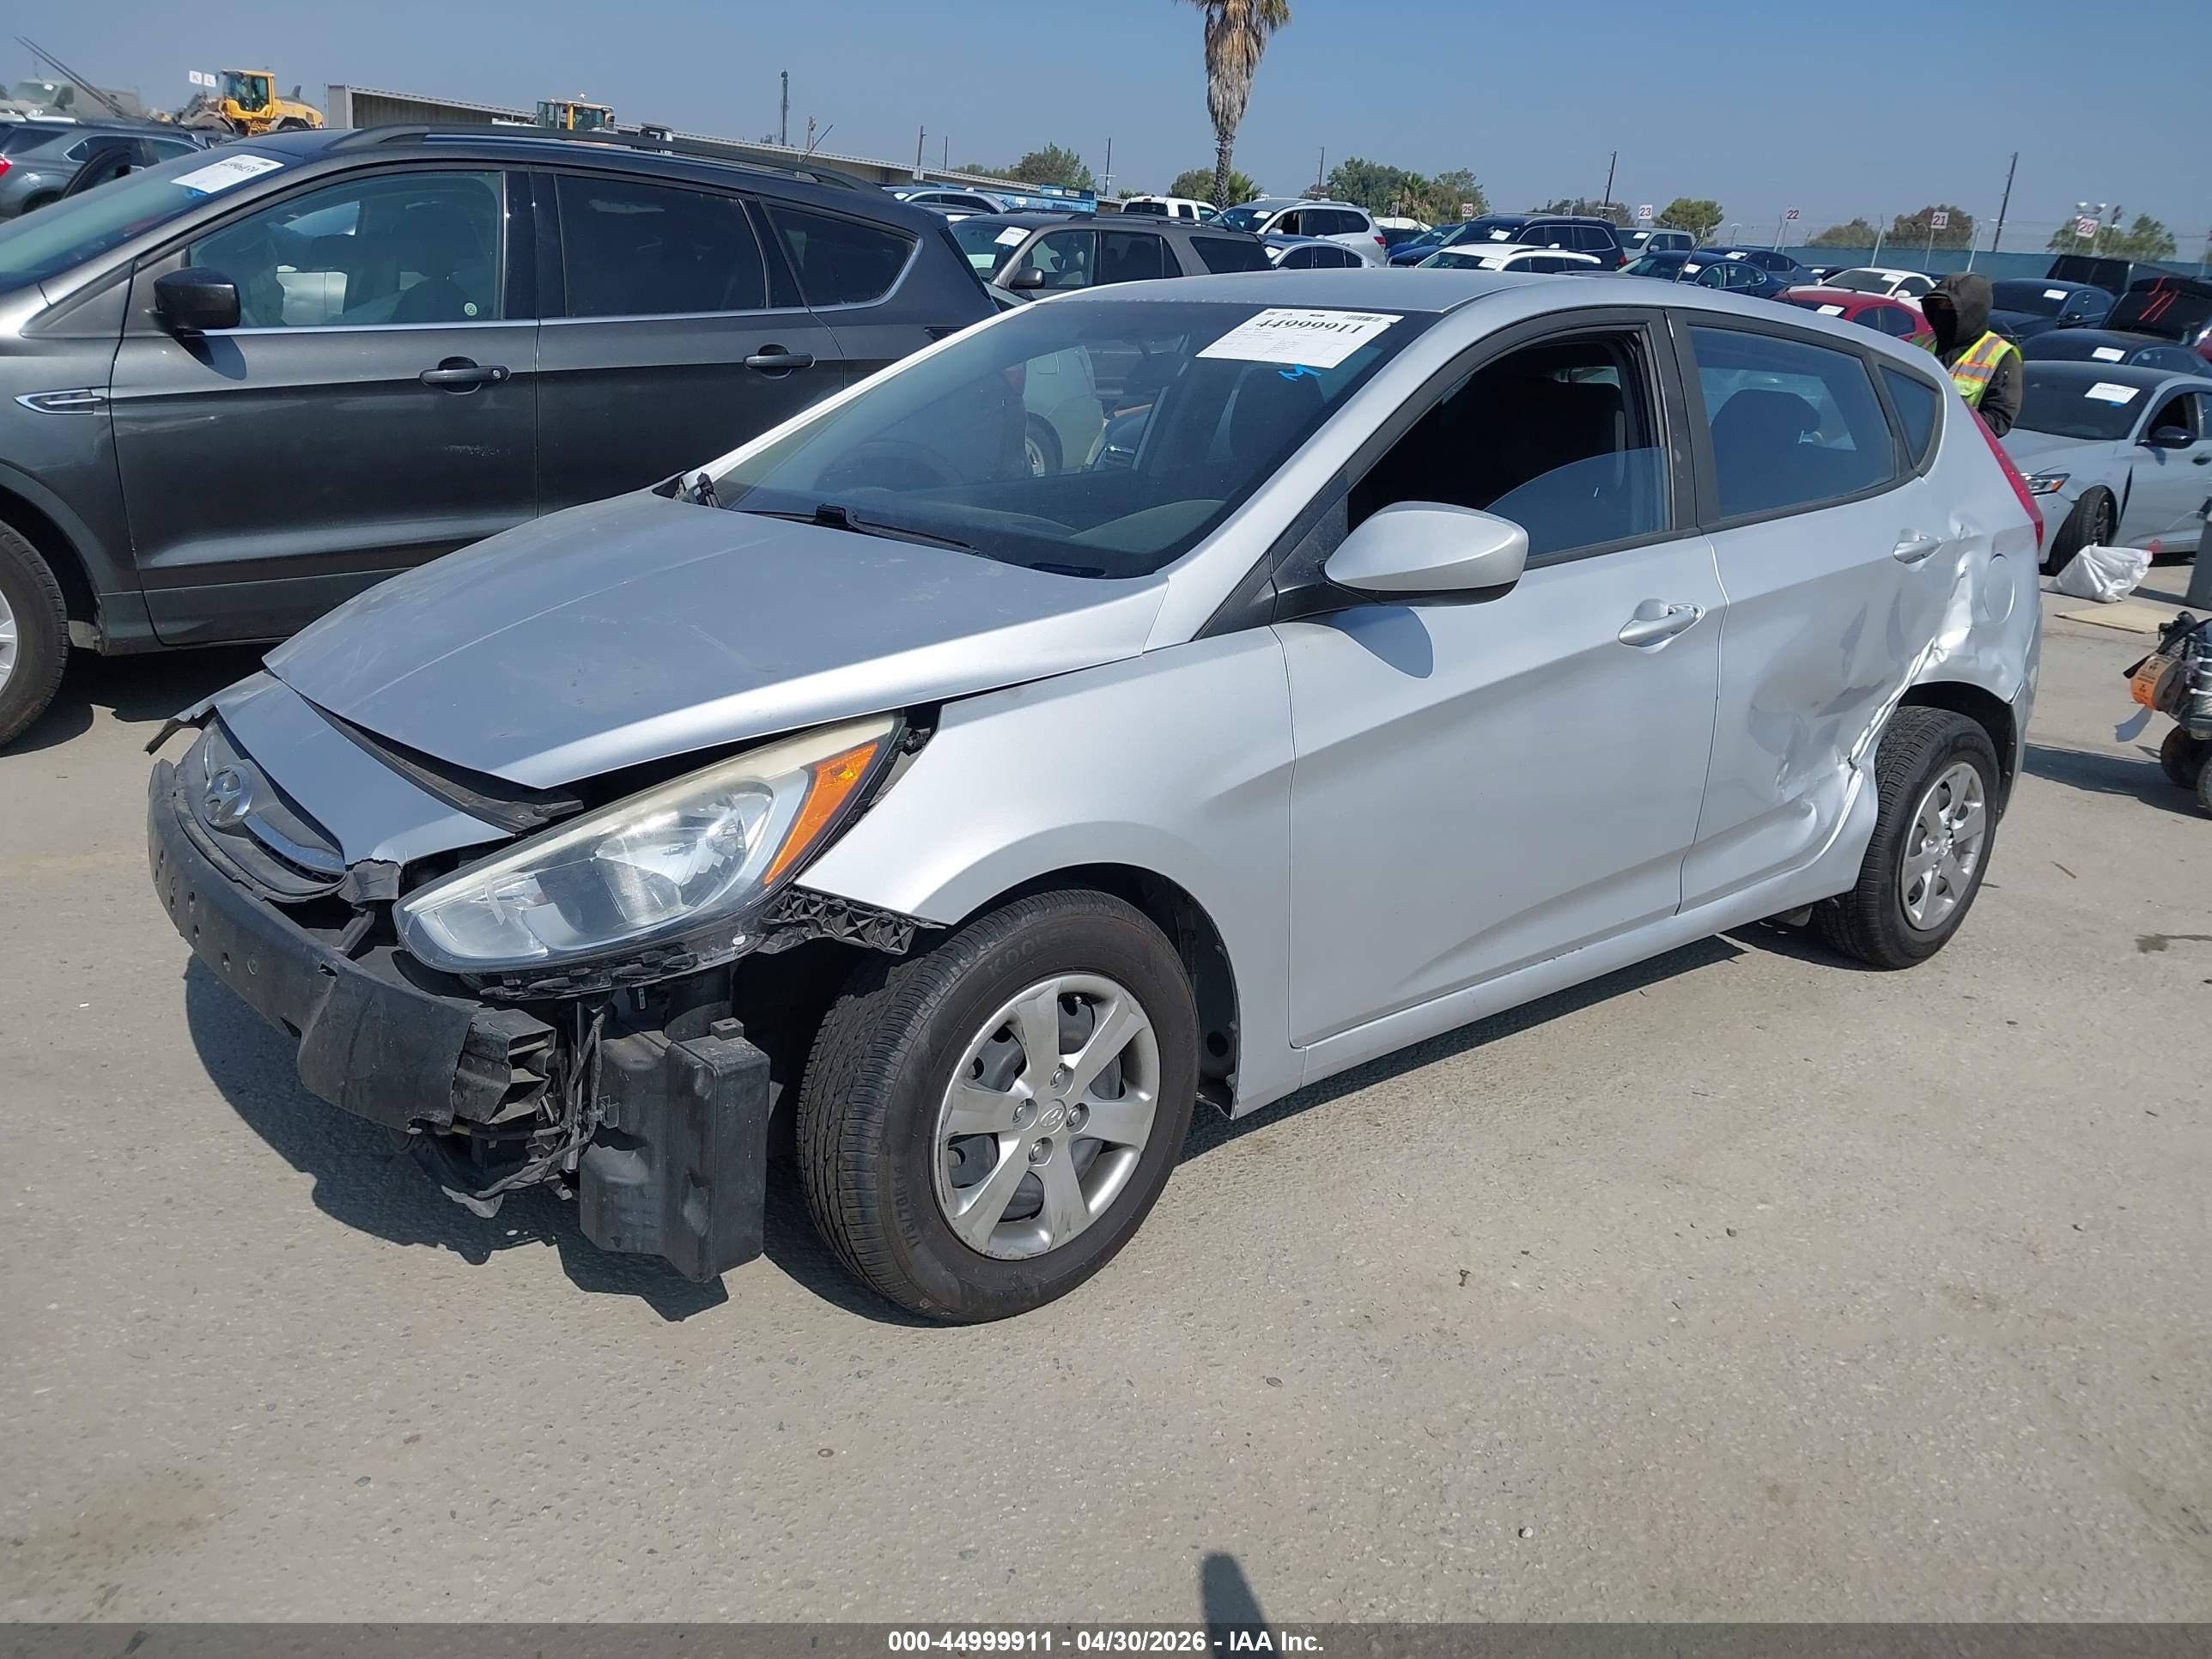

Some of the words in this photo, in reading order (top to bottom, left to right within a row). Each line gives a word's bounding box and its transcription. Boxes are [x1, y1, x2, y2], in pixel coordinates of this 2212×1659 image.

[1462, 205, 1473, 215] 25
[1639, 208, 1651, 216] 23
[1786, 210, 1800, 220] 22
[1934, 215, 1946, 226] 21
[2079, 222, 2094, 234] 20
[1256, 319, 1367, 334] 44999911
